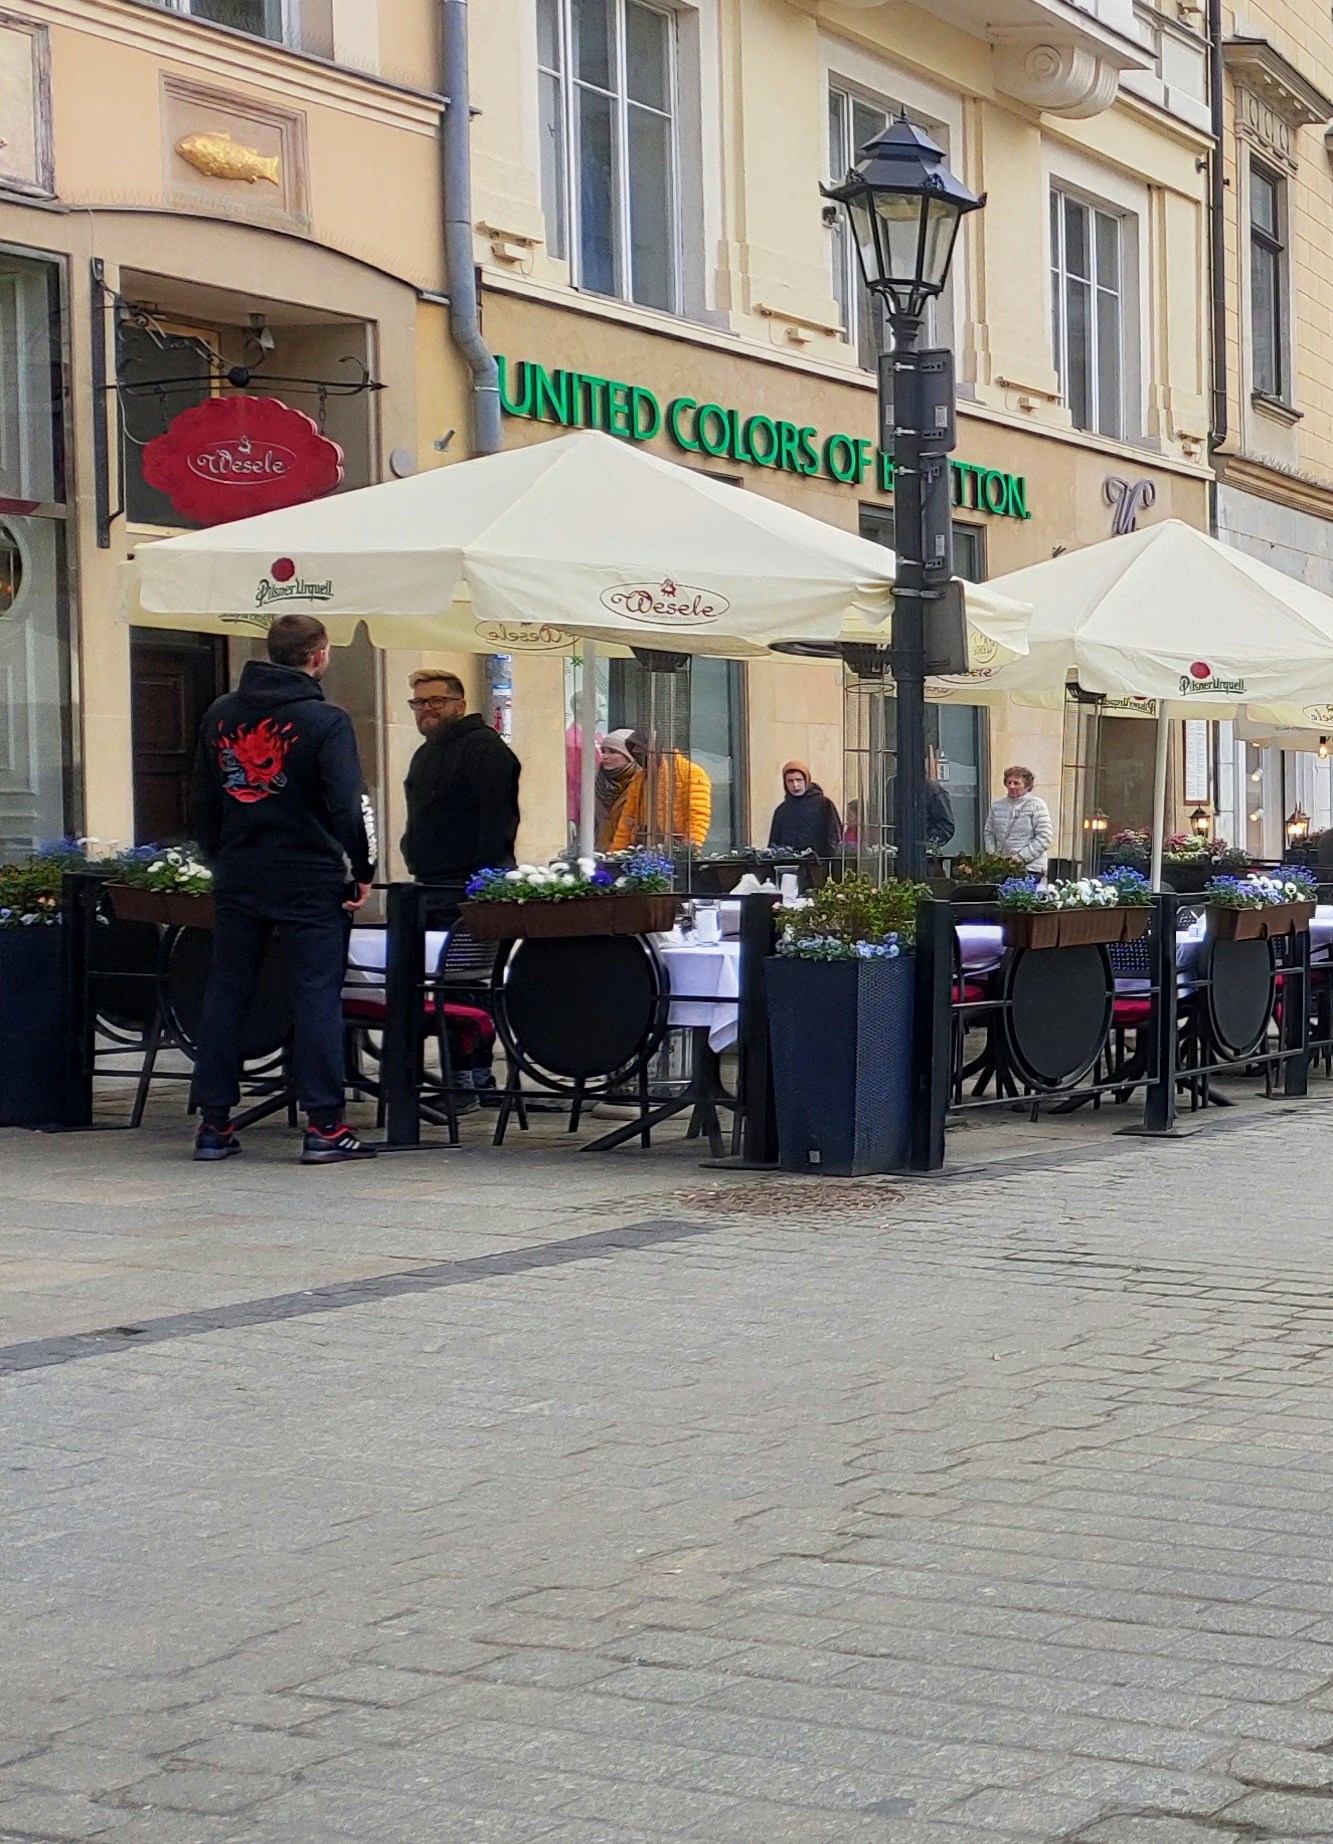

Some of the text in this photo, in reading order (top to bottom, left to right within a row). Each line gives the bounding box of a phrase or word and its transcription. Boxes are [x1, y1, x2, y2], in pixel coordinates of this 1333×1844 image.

[494, 355, 661, 441] UNITED
[669, 396, 819, 475] COLORS
[827, 433, 872, 485] OF
[197, 449, 286, 474] Wesele
[255, 578, 296, 608] Pilsner
[610, 590, 718, 618] Wesele
[1179, 675, 1212, 696] Pilsner
